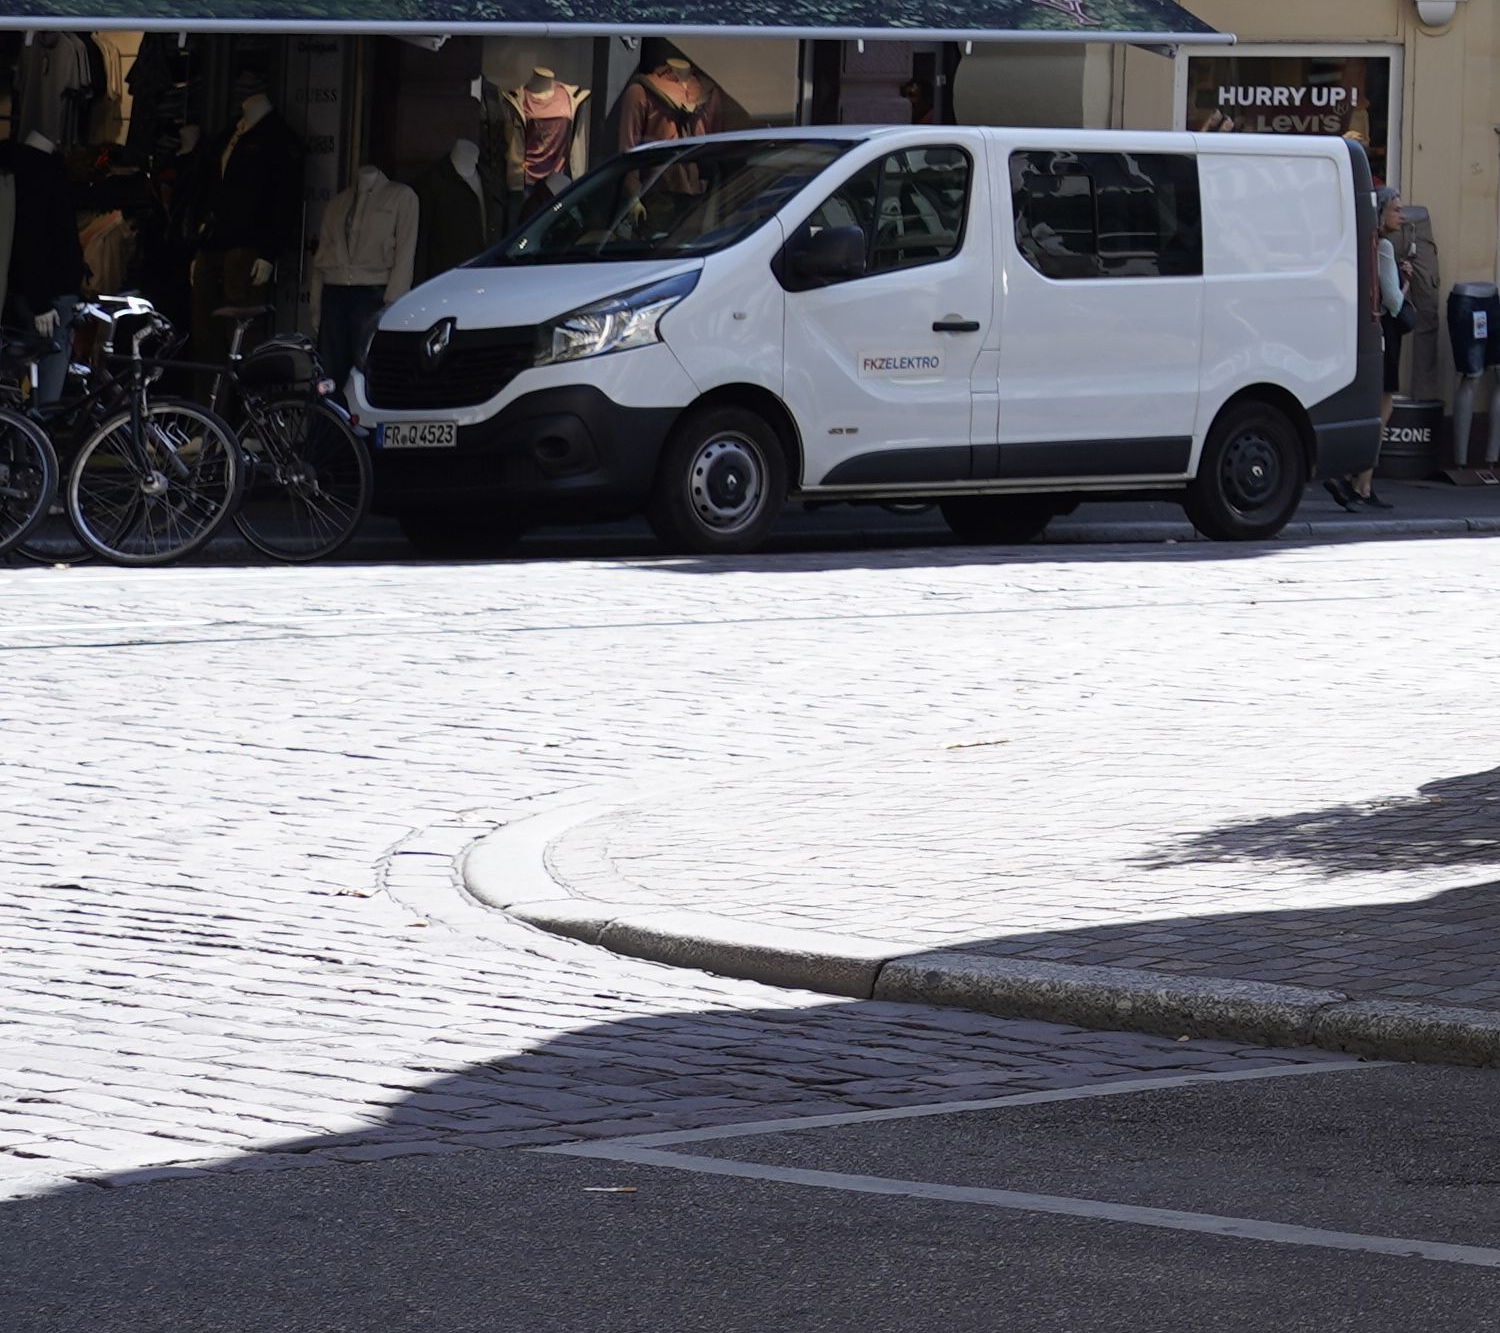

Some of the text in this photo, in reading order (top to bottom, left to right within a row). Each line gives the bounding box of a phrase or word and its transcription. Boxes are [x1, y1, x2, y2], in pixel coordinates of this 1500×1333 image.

[1218, 86, 1307, 106] HURRY
[1311, 86, 1347, 107] UP
[384, 424, 454, 445] FR Q 4523
